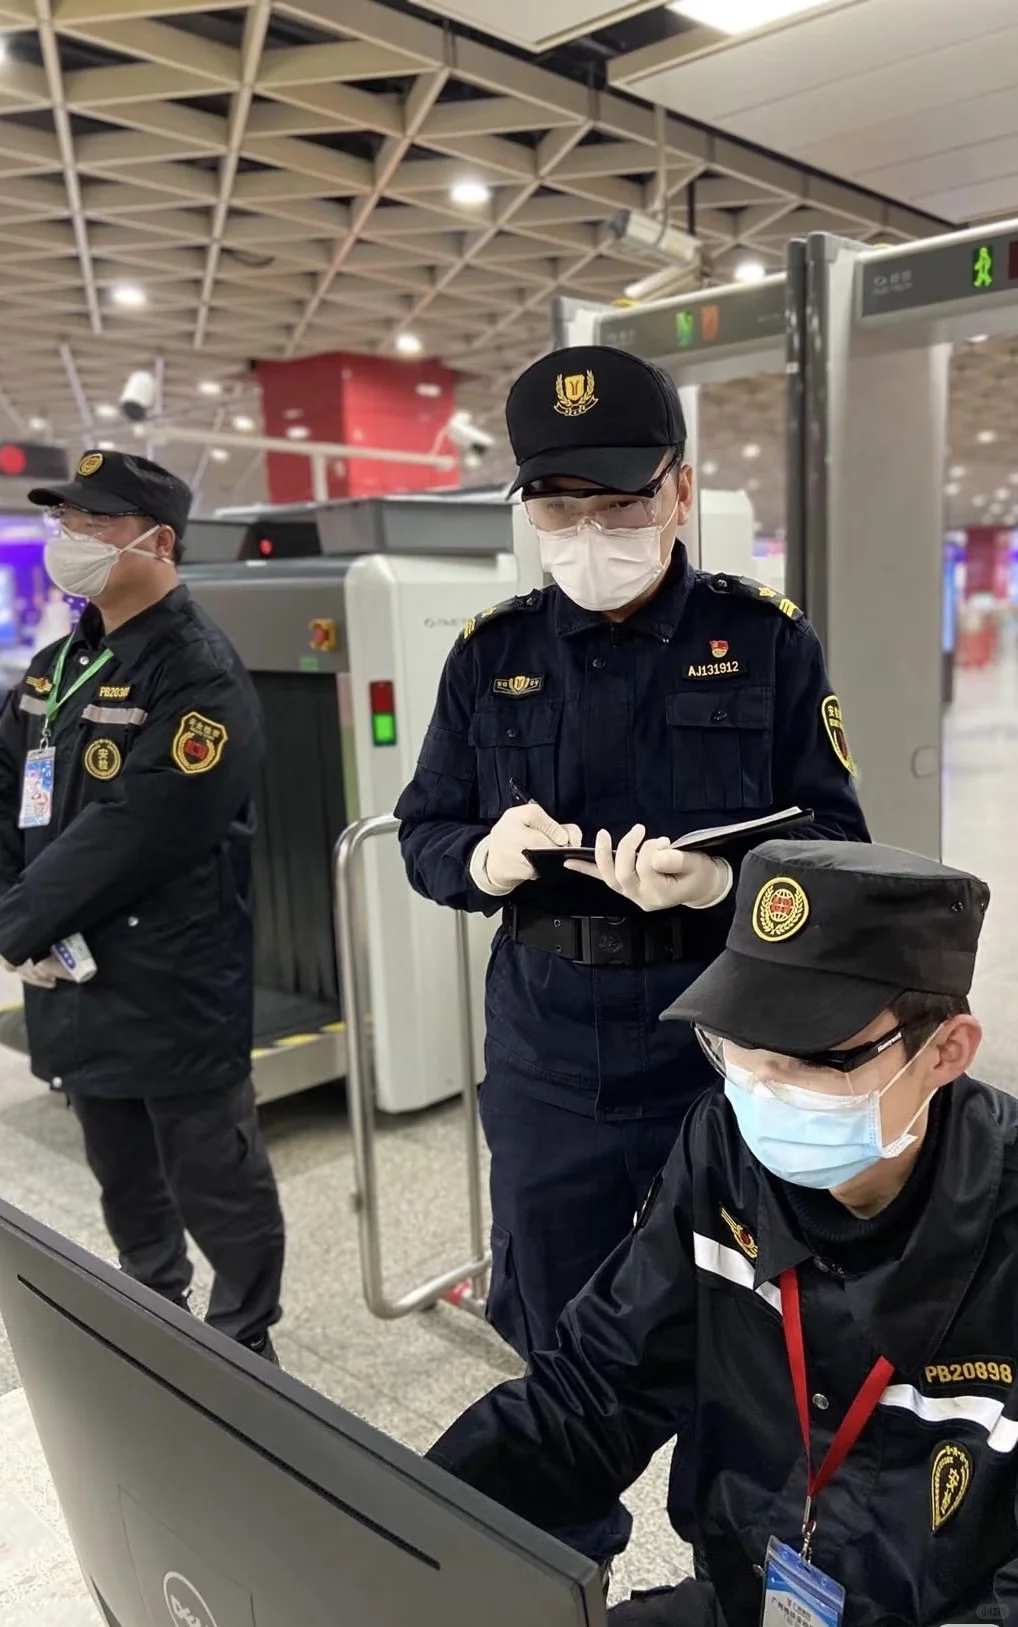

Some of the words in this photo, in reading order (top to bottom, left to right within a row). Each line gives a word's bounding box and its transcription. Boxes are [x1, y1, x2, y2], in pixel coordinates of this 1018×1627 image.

[688, 661, 739, 677] AJ131912
[100, 686, 131, 698] PB203
[925, 1362, 1013, 1384] PB20898
